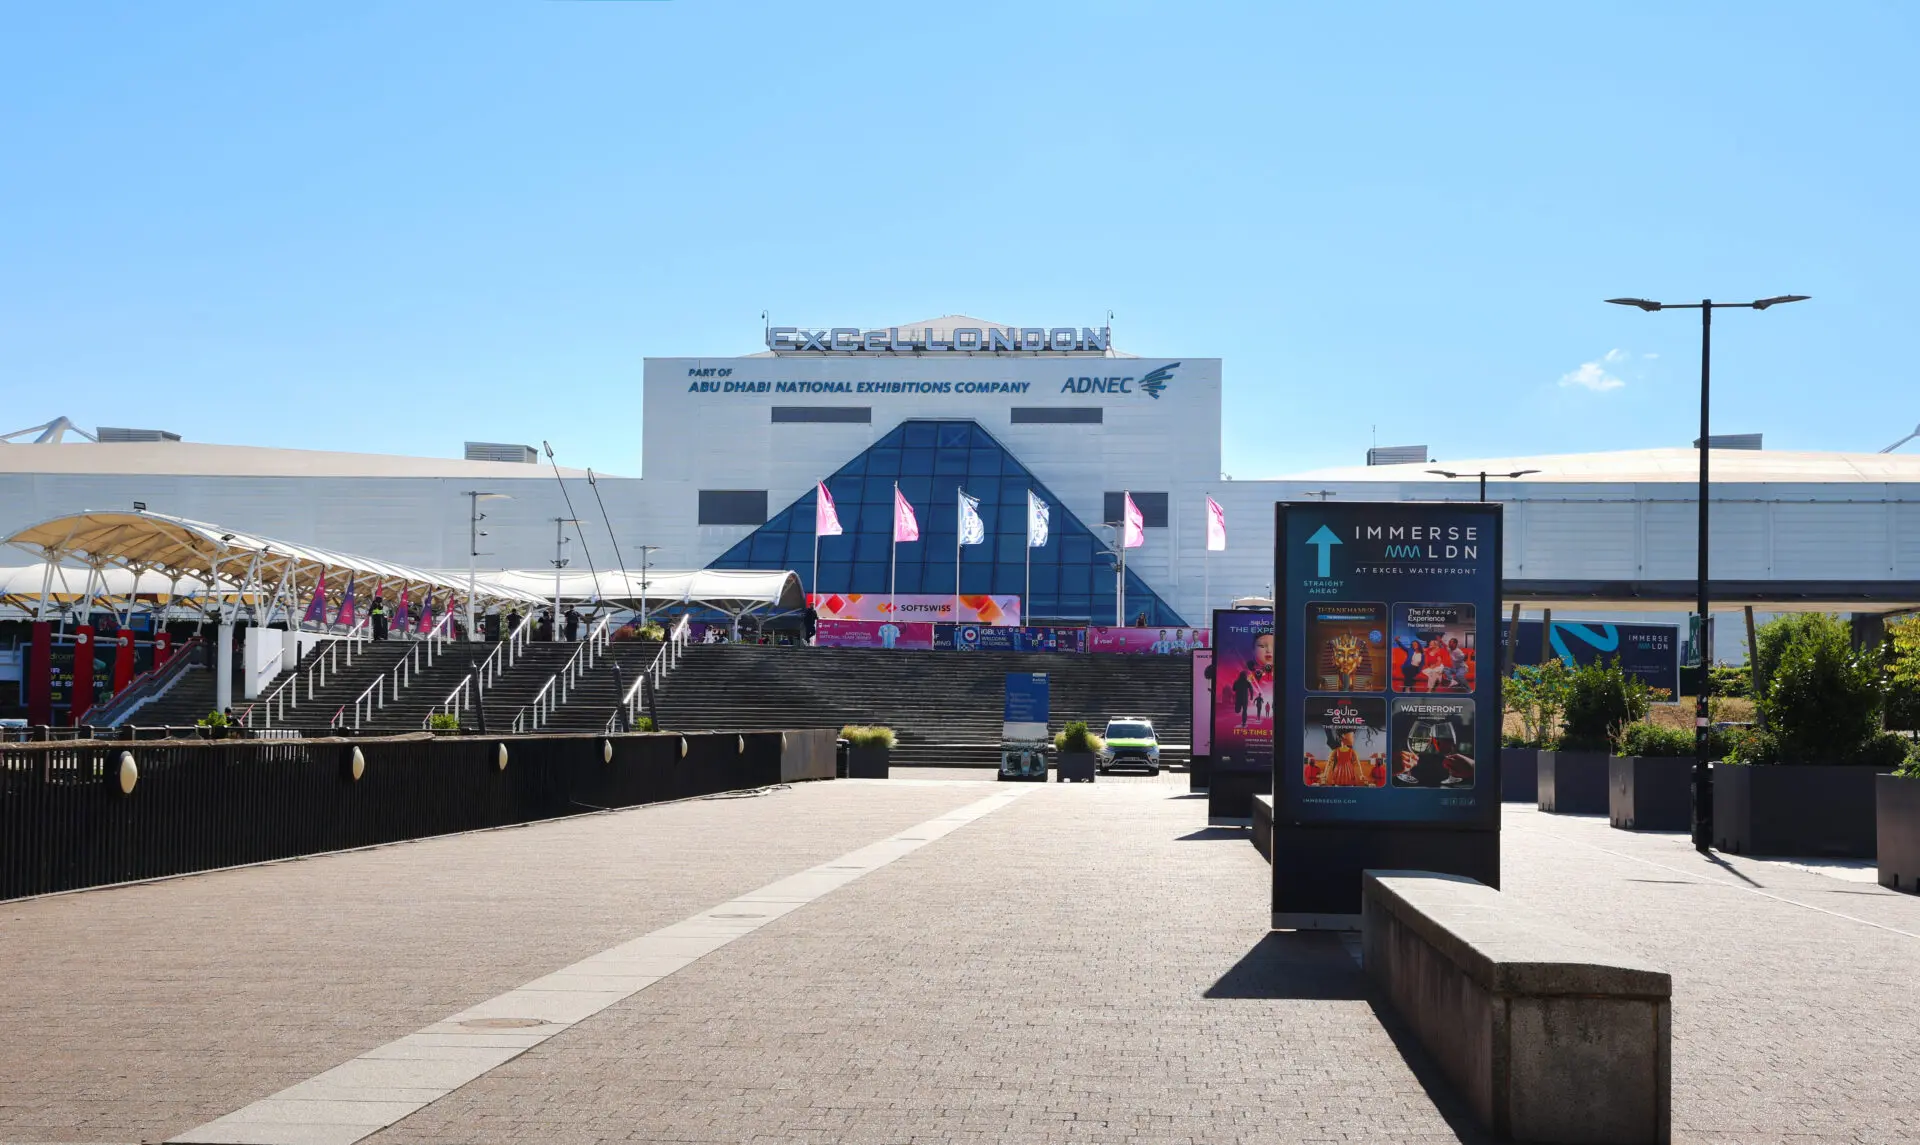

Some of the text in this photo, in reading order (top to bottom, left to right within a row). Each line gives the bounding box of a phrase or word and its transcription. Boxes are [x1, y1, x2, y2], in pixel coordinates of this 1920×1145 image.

[925, 327, 1106, 351] LONDON
[688, 368, 733, 377] PART OF
[688, 381, 1031, 393] ABU DHABI NATIONAL EXHIBITIONS COMPANY
[1060, 377, 1134, 393] ADNEC
[1355, 526, 1477, 540] IMMERSE
[1428, 545, 1477, 559] LDN
[1409, 567, 1477, 575] WATERFRONT
[900, 604, 951, 612] SOFTSWISS
[1400, 705, 1463, 713] WATERFRONT
